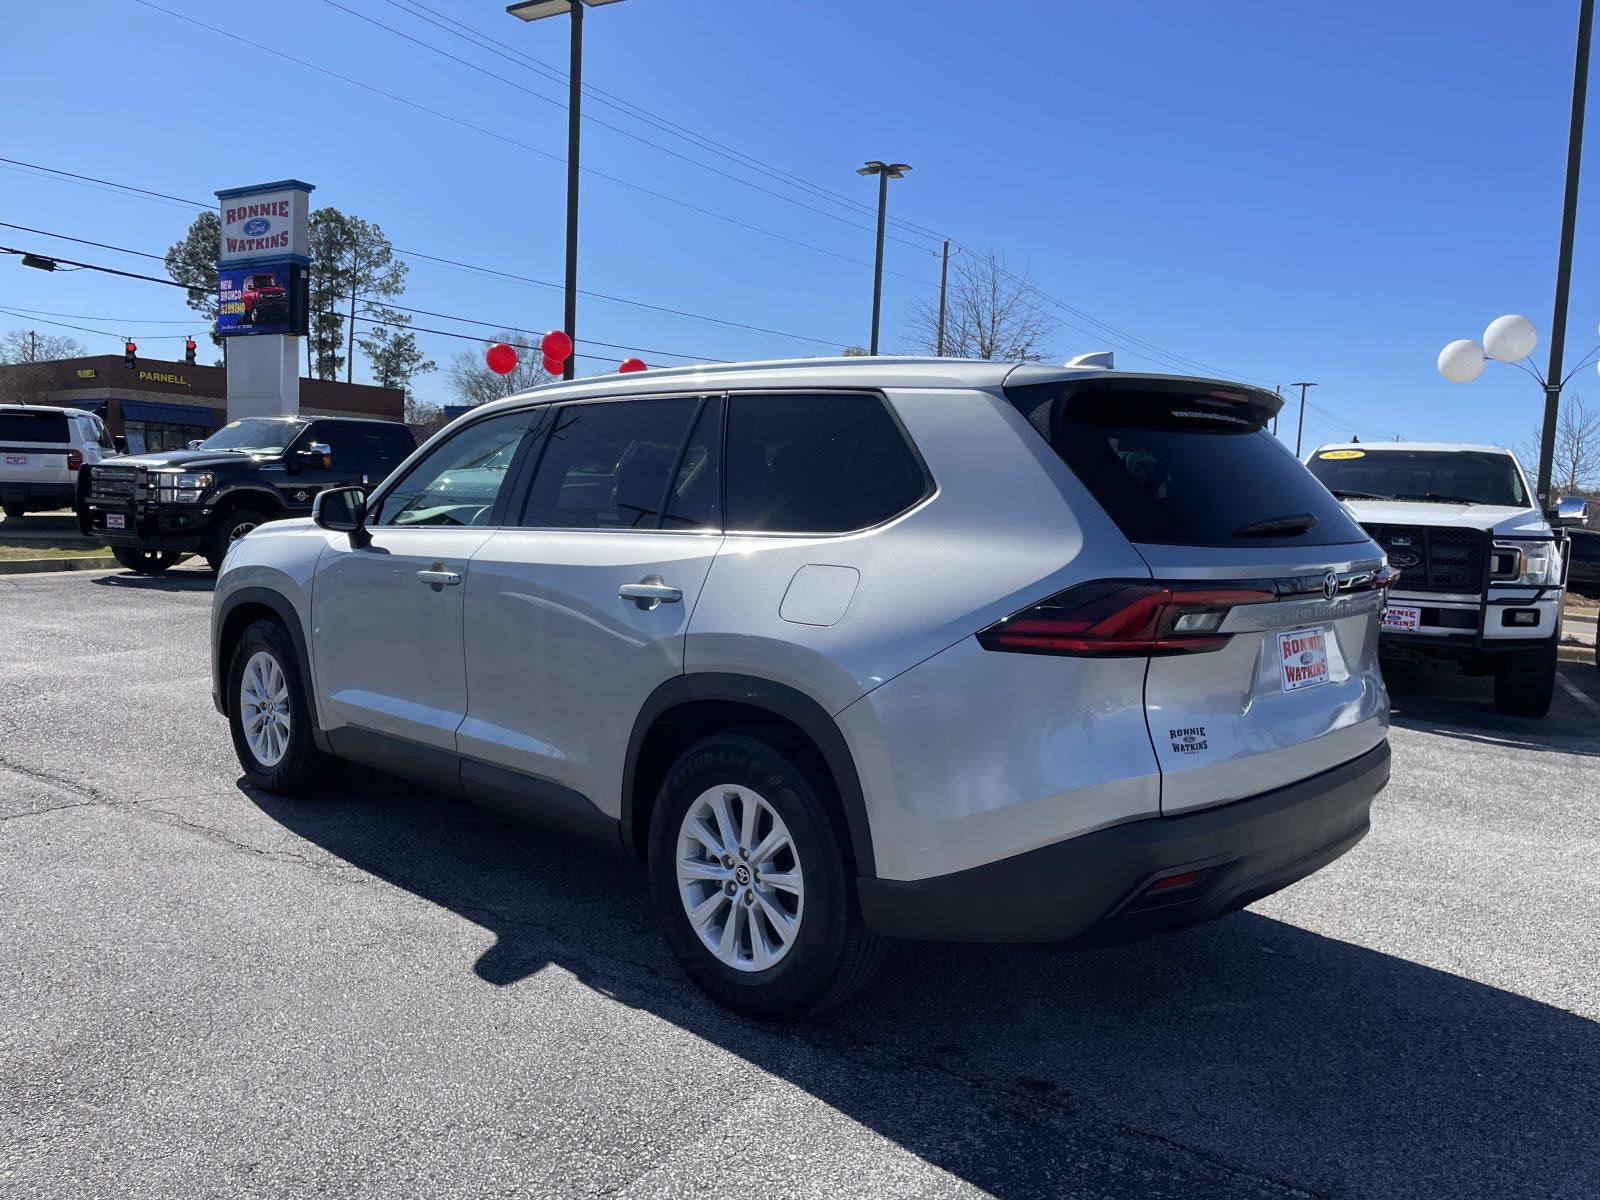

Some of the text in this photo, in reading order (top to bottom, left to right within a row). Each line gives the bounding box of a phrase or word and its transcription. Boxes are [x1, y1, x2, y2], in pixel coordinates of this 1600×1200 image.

[226, 201, 289, 225] RONNIE
[226, 230, 289, 253] WATKINS
[220, 280, 233, 290] NEW
[220, 290, 242, 301] BRONCO
[139, 371, 187, 385] PARNELL
[1388, 609, 1416, 618] NNIE
[1382, 620, 1416, 628] ATKINS
[1282, 635, 1324, 660] RONNIE
[1285, 659, 1326, 683] WATKINS
[1169, 727, 1206, 740] RONNIE
[1171, 740, 1208, 752] WATKINS
